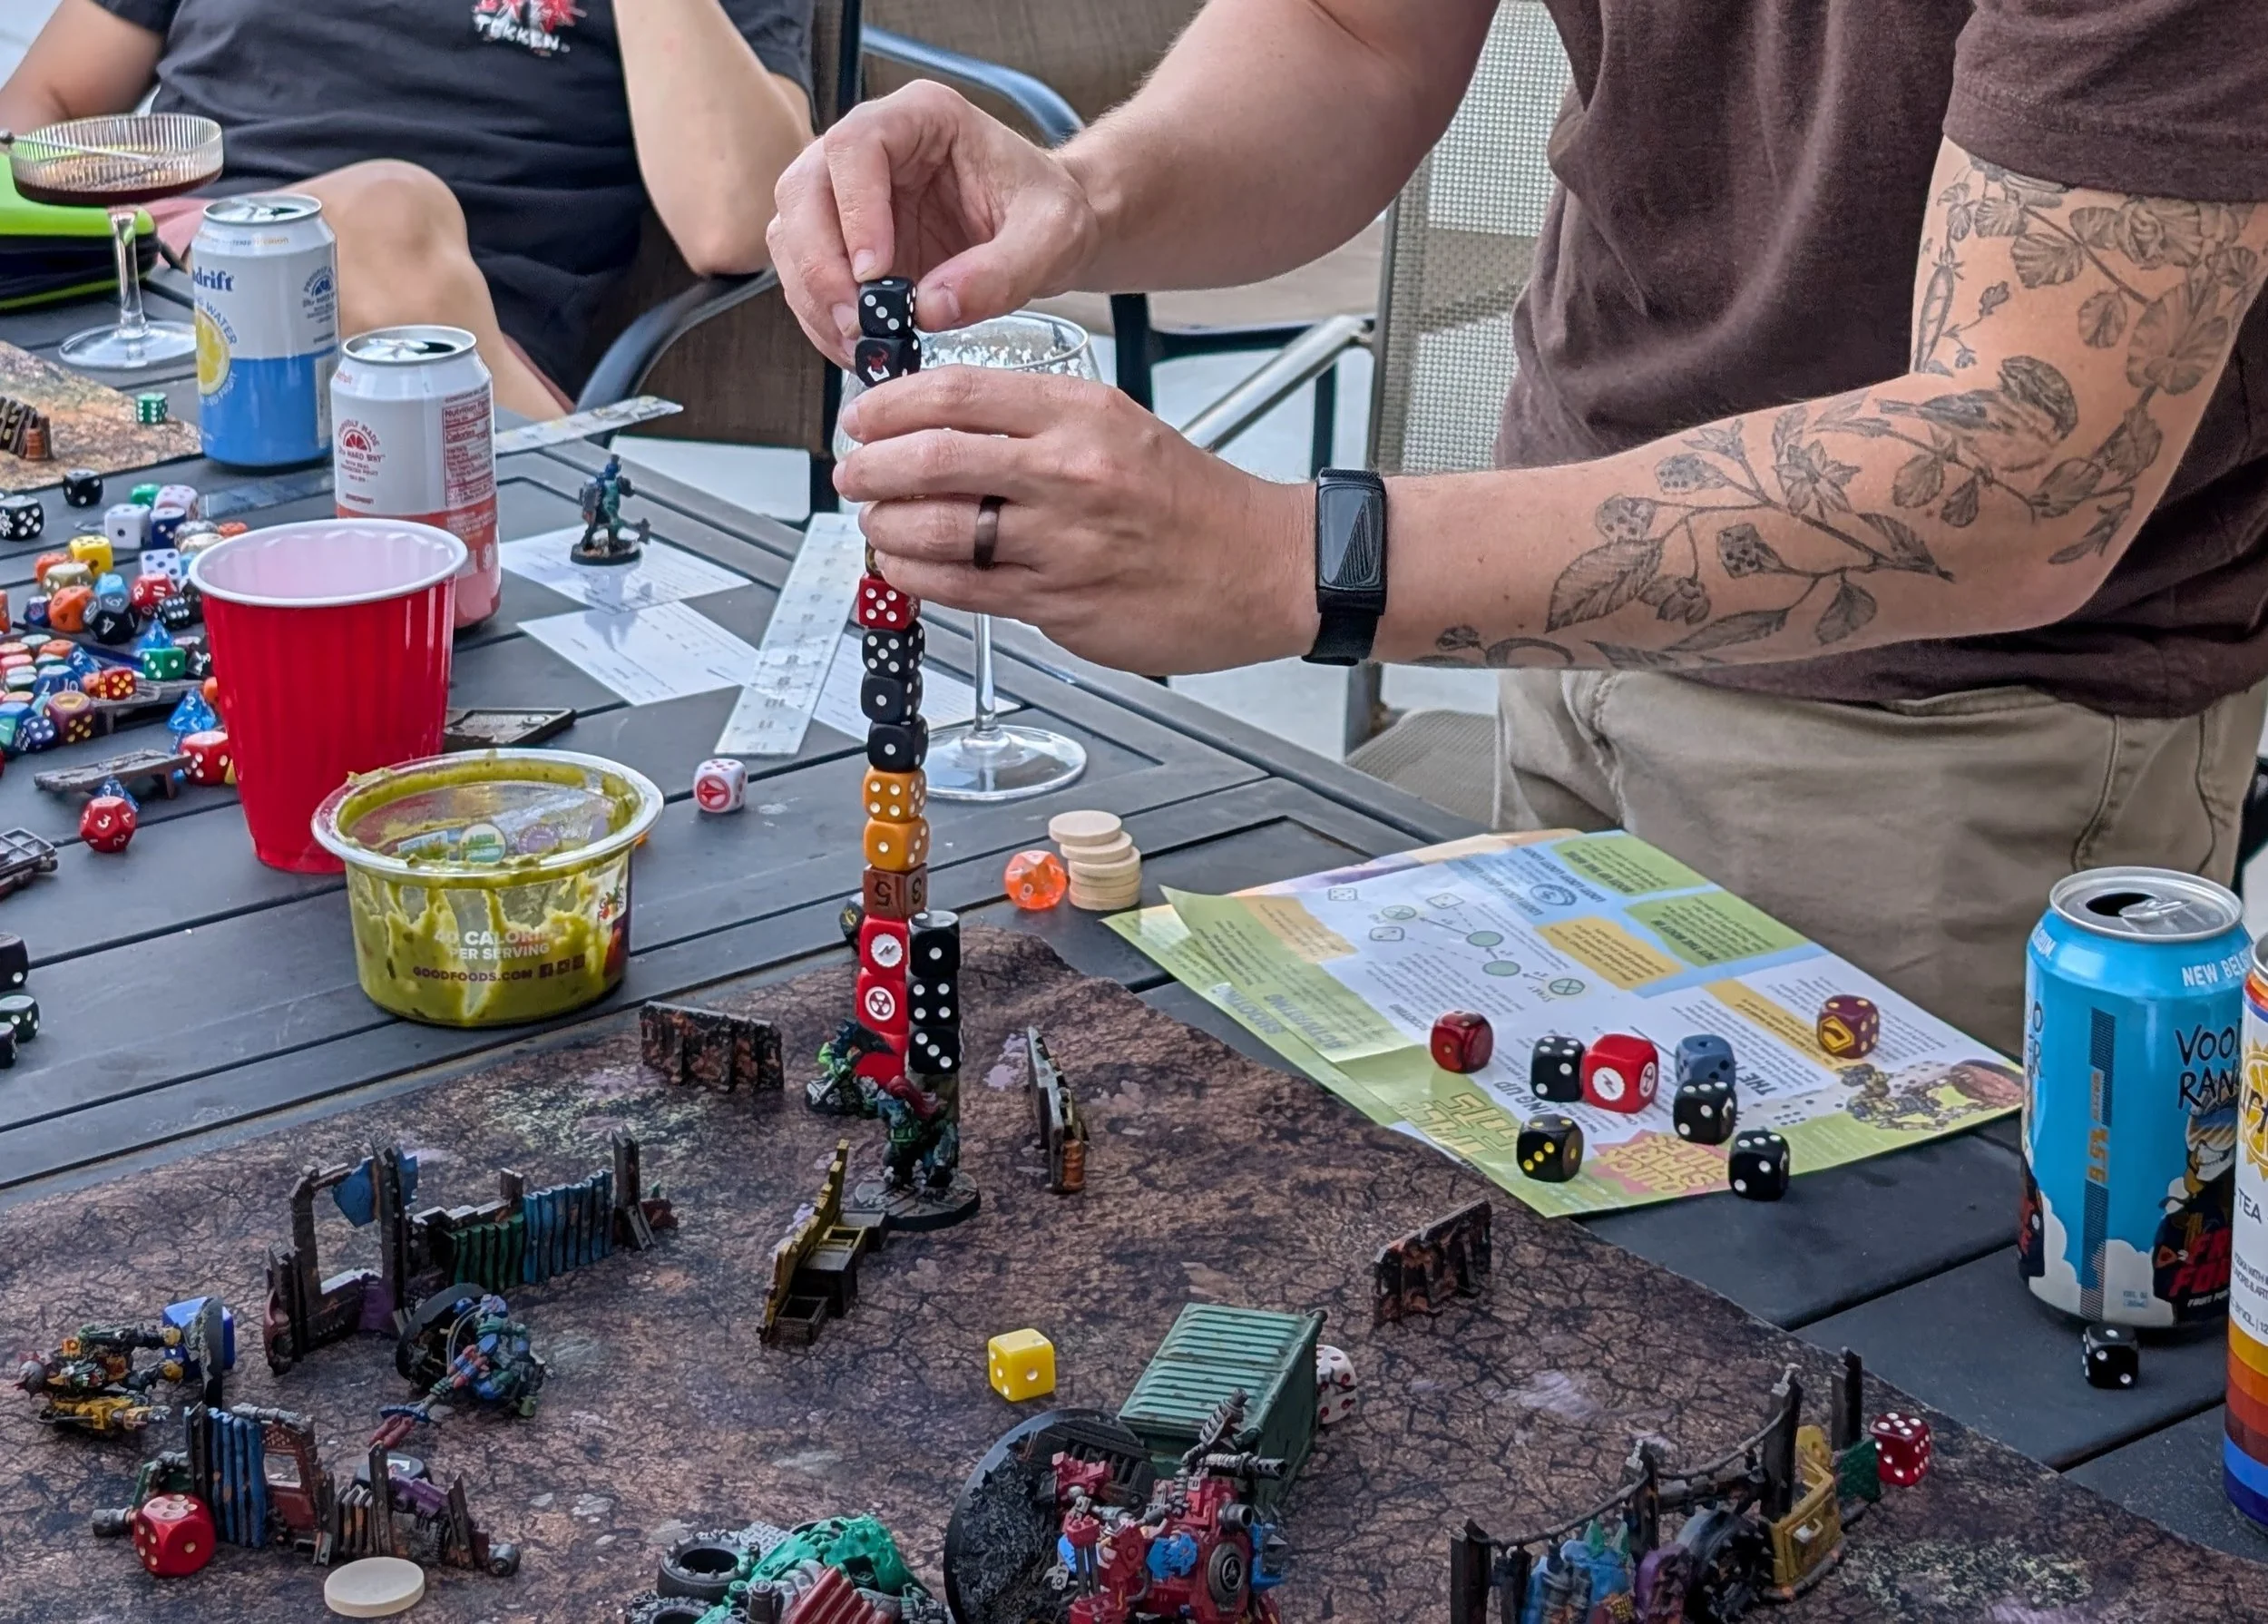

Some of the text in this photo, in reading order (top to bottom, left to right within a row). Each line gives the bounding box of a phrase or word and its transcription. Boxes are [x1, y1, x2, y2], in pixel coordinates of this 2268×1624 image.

[474, 14, 560, 51] TEKKEN
[205, 300, 238, 345] WATER
[361, 423, 380, 447] MADE
[97, 814, 112, 828] 3
[450, 943, 550, 960] PER SERVING
[413, 965, 533, 982] GOODFOODS.COM
[2181, 963, 2218, 987] NEW
[1733, 1071, 1782, 1095] THE
[2178, 1059, 2240, 1110] RAN
[1597, 1150, 1685, 1195] QUICK
[1620, 1140, 1718, 1186] START
[2238, 1187, 2262, 1224] TEA
[2168, 1258, 2232, 1298] FOR
